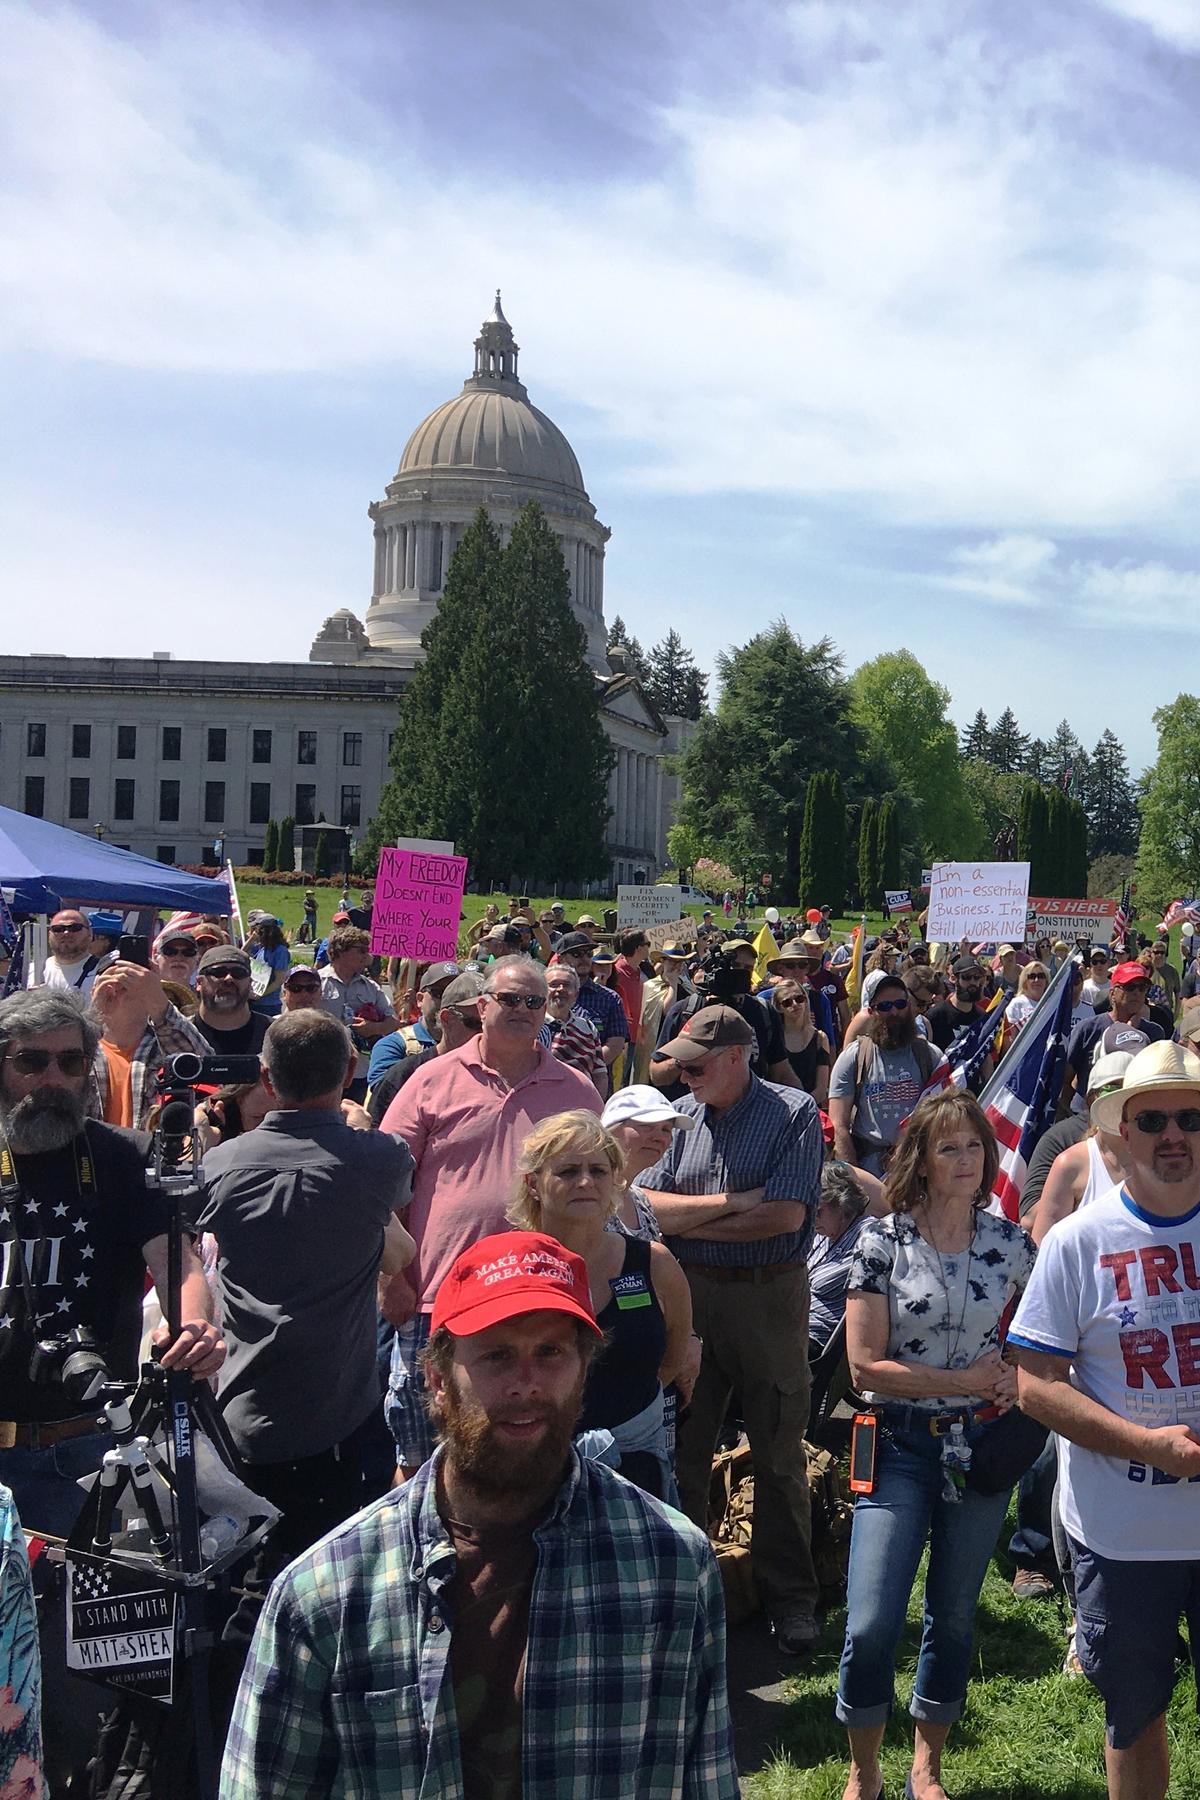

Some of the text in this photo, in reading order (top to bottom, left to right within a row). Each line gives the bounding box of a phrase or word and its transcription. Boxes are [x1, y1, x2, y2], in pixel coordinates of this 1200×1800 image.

[410, 854, 465, 886] FREEDOM
[932, 864, 961, 885] I'm
[972, 868, 984, 880] a
[433, 886, 453, 905] END
[889, 894, 909, 904] CULP
[940, 880, 1026, 899] non-essential
[376, 904, 453, 930] WHERE YOUR
[934, 902, 994, 917] Business.
[998, 901, 1022, 916] I'm
[1044, 901, 1061, 912] IS
[1064, 902, 1110, 914] HERE
[649, 920, 694, 940] NO NEW
[930, 921, 1025, 937] Still WORKING
[1038, 915, 1100, 928] ONSTITUTION
[372, 926, 455, 958] FEAR BEGINS
[1, 1150, 12, 1176] Nikon
[81, 1156, 92, 1184] Nikon
[475, 1254, 518, 1280] MAKE
[484, 1266, 535, 1286] GREAT
[614, 1279, 643, 1291] EYMAN
[618, 1275, 636, 1284] TIM
[1144, 1298, 1178, 1324] TO
[180, 1417, 191, 1457] SLIK
[77, 1597, 168, 1626] I STAND WITH
[79, 1631, 171, 1665] MATT SHEA
